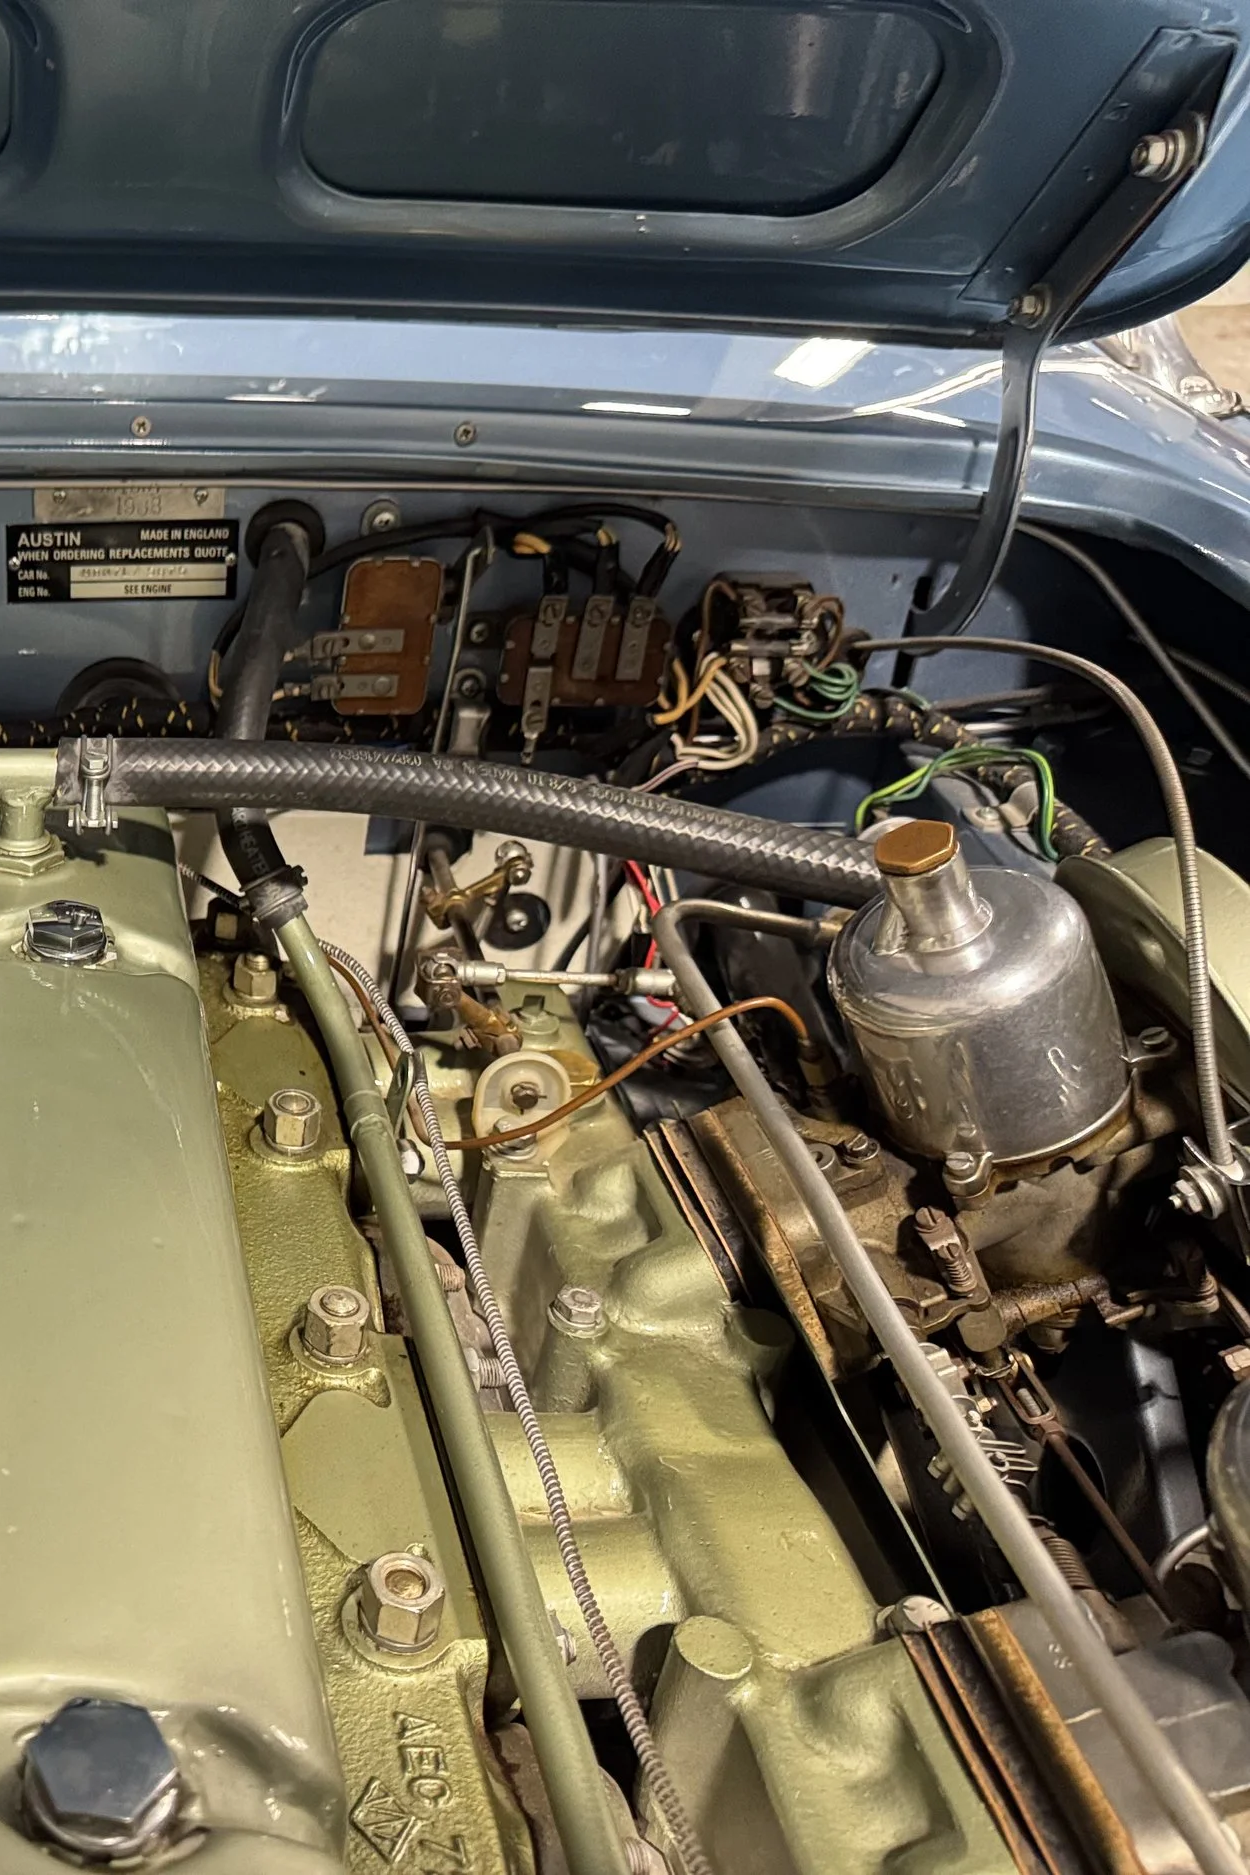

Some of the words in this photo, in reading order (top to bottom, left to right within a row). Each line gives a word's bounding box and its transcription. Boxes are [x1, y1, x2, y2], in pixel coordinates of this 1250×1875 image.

[17, 531, 81, 548] AUSTIN
[140, 529, 170, 541] MADE
[171, 529, 182, 540] IN
[184, 528, 229, 540] ENGLAND
[17, 550, 49, 562] WHEN
[53, 549, 105, 561] ORDERING
[109, 547, 190, 560] REPLACEMENTS
[194, 546, 229, 558] QUOTE
[18, 569, 34, 581] CAR
[18, 586, 35, 598] ENG
[124, 584, 140, 595] SEE
[141, 583, 172, 595] ENGINE
[393, 1711, 454, 1808] AEC
